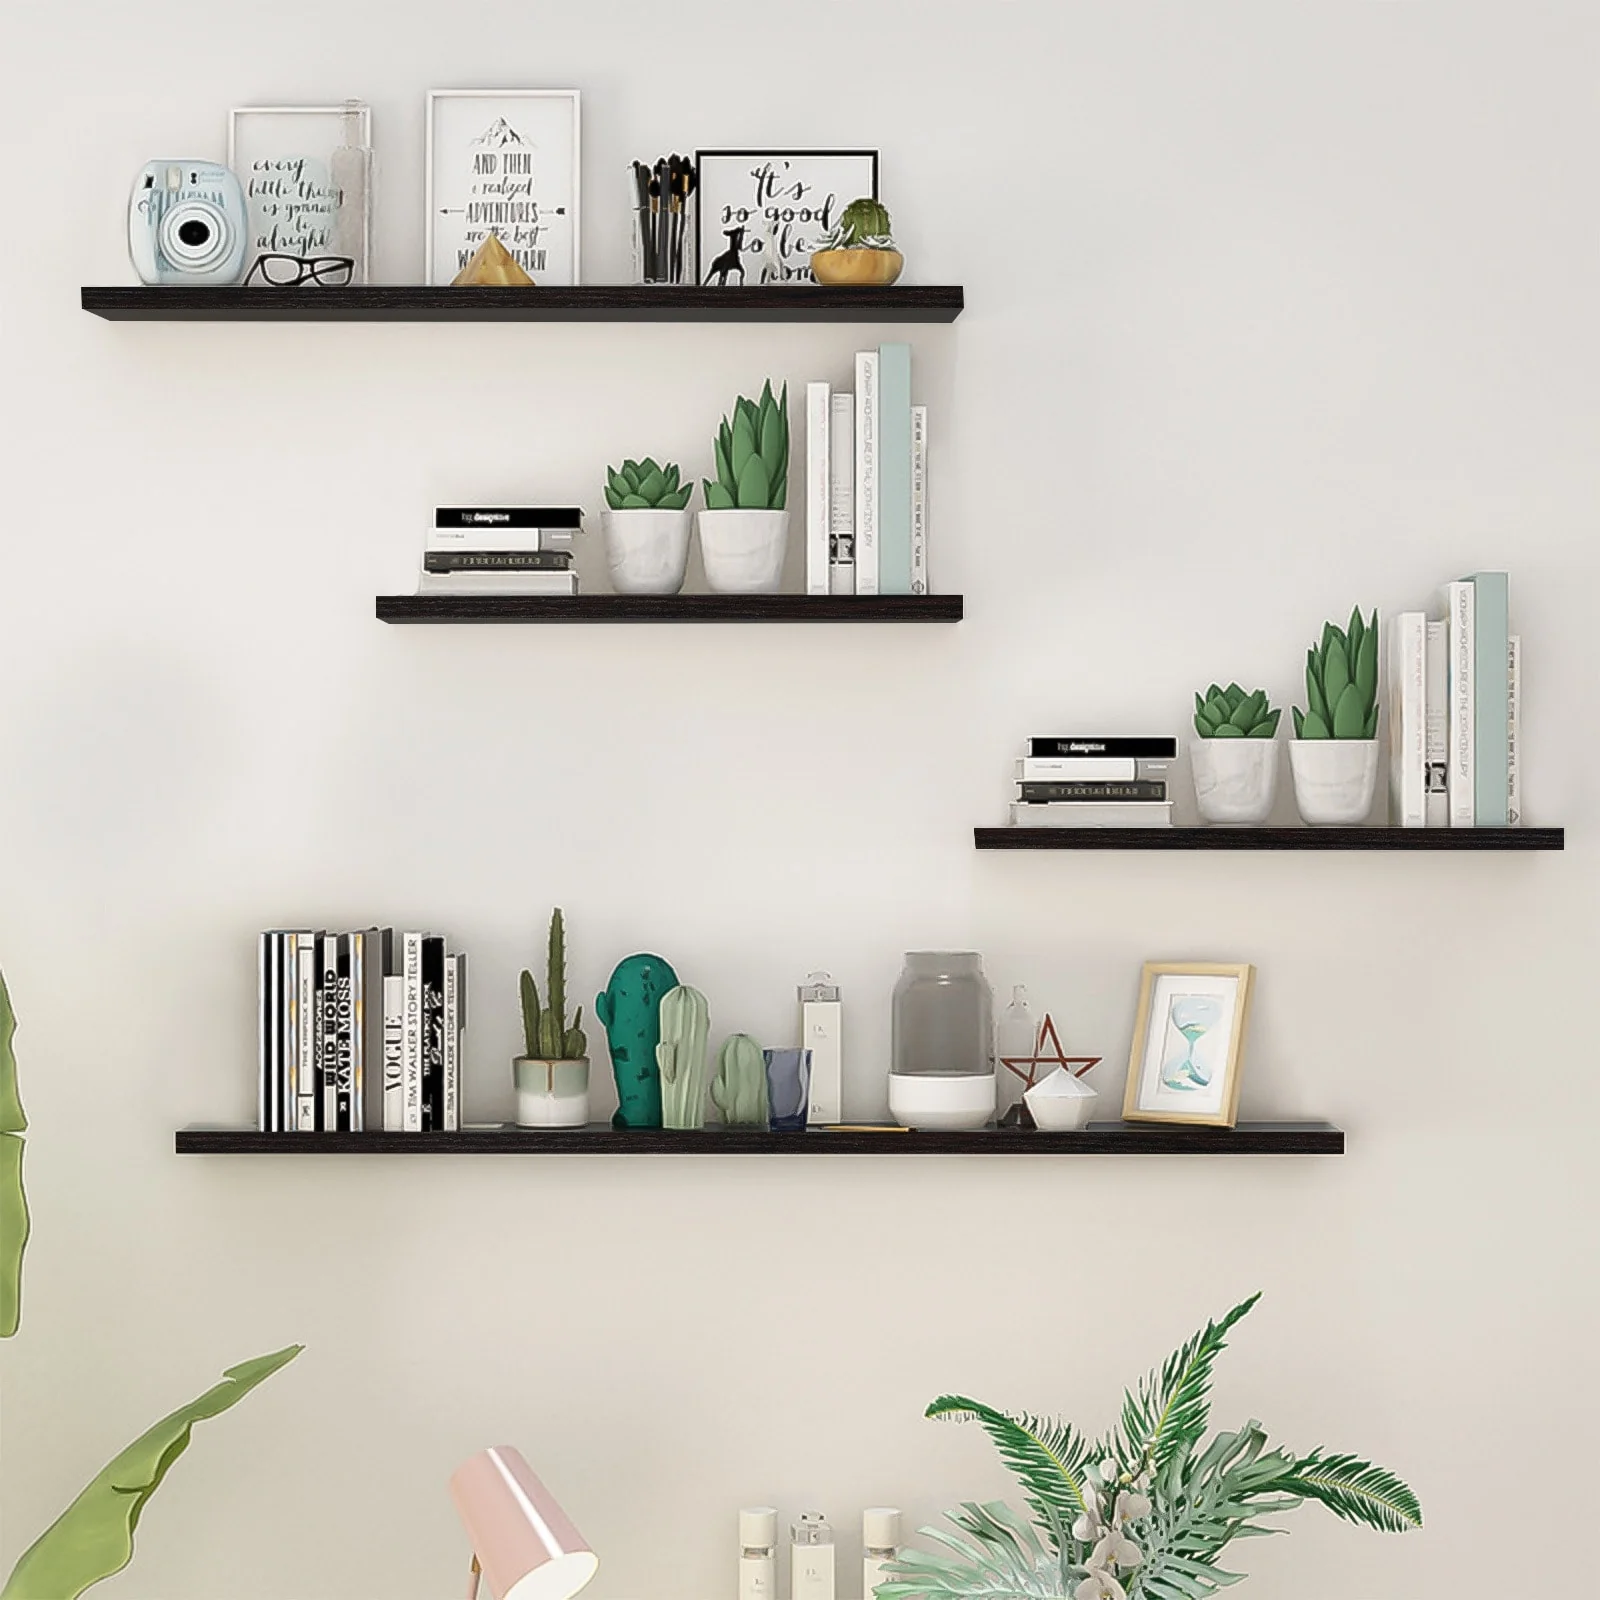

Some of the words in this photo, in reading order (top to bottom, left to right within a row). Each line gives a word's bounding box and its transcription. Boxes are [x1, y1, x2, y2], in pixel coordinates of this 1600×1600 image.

[252, 159, 304, 184] every
[472, 153, 498, 175] AND
[502, 153, 531, 175] THEN
[248, 178, 292, 199] little
[482, 176, 533, 202] realized
[750, 161, 811, 207] It's
[465, 202, 539, 224] ADVENTURES
[721, 206, 757, 224] so
[764, 193, 834, 231] good
[514, 225, 548, 249] best
[779, 223, 816, 259] be
[407, 940, 417, 981] TELLER
[324, 969, 337, 1035] WORLD
[337, 976, 350, 1034] MOSS
[407, 986, 417, 1025] STORY
[324, 1041, 337, 1086] WILD
[337, 1040, 350, 1093] KATE
[385, 1016, 402, 1091] VOGUE
[407, 1030, 417, 1082] WALKER
